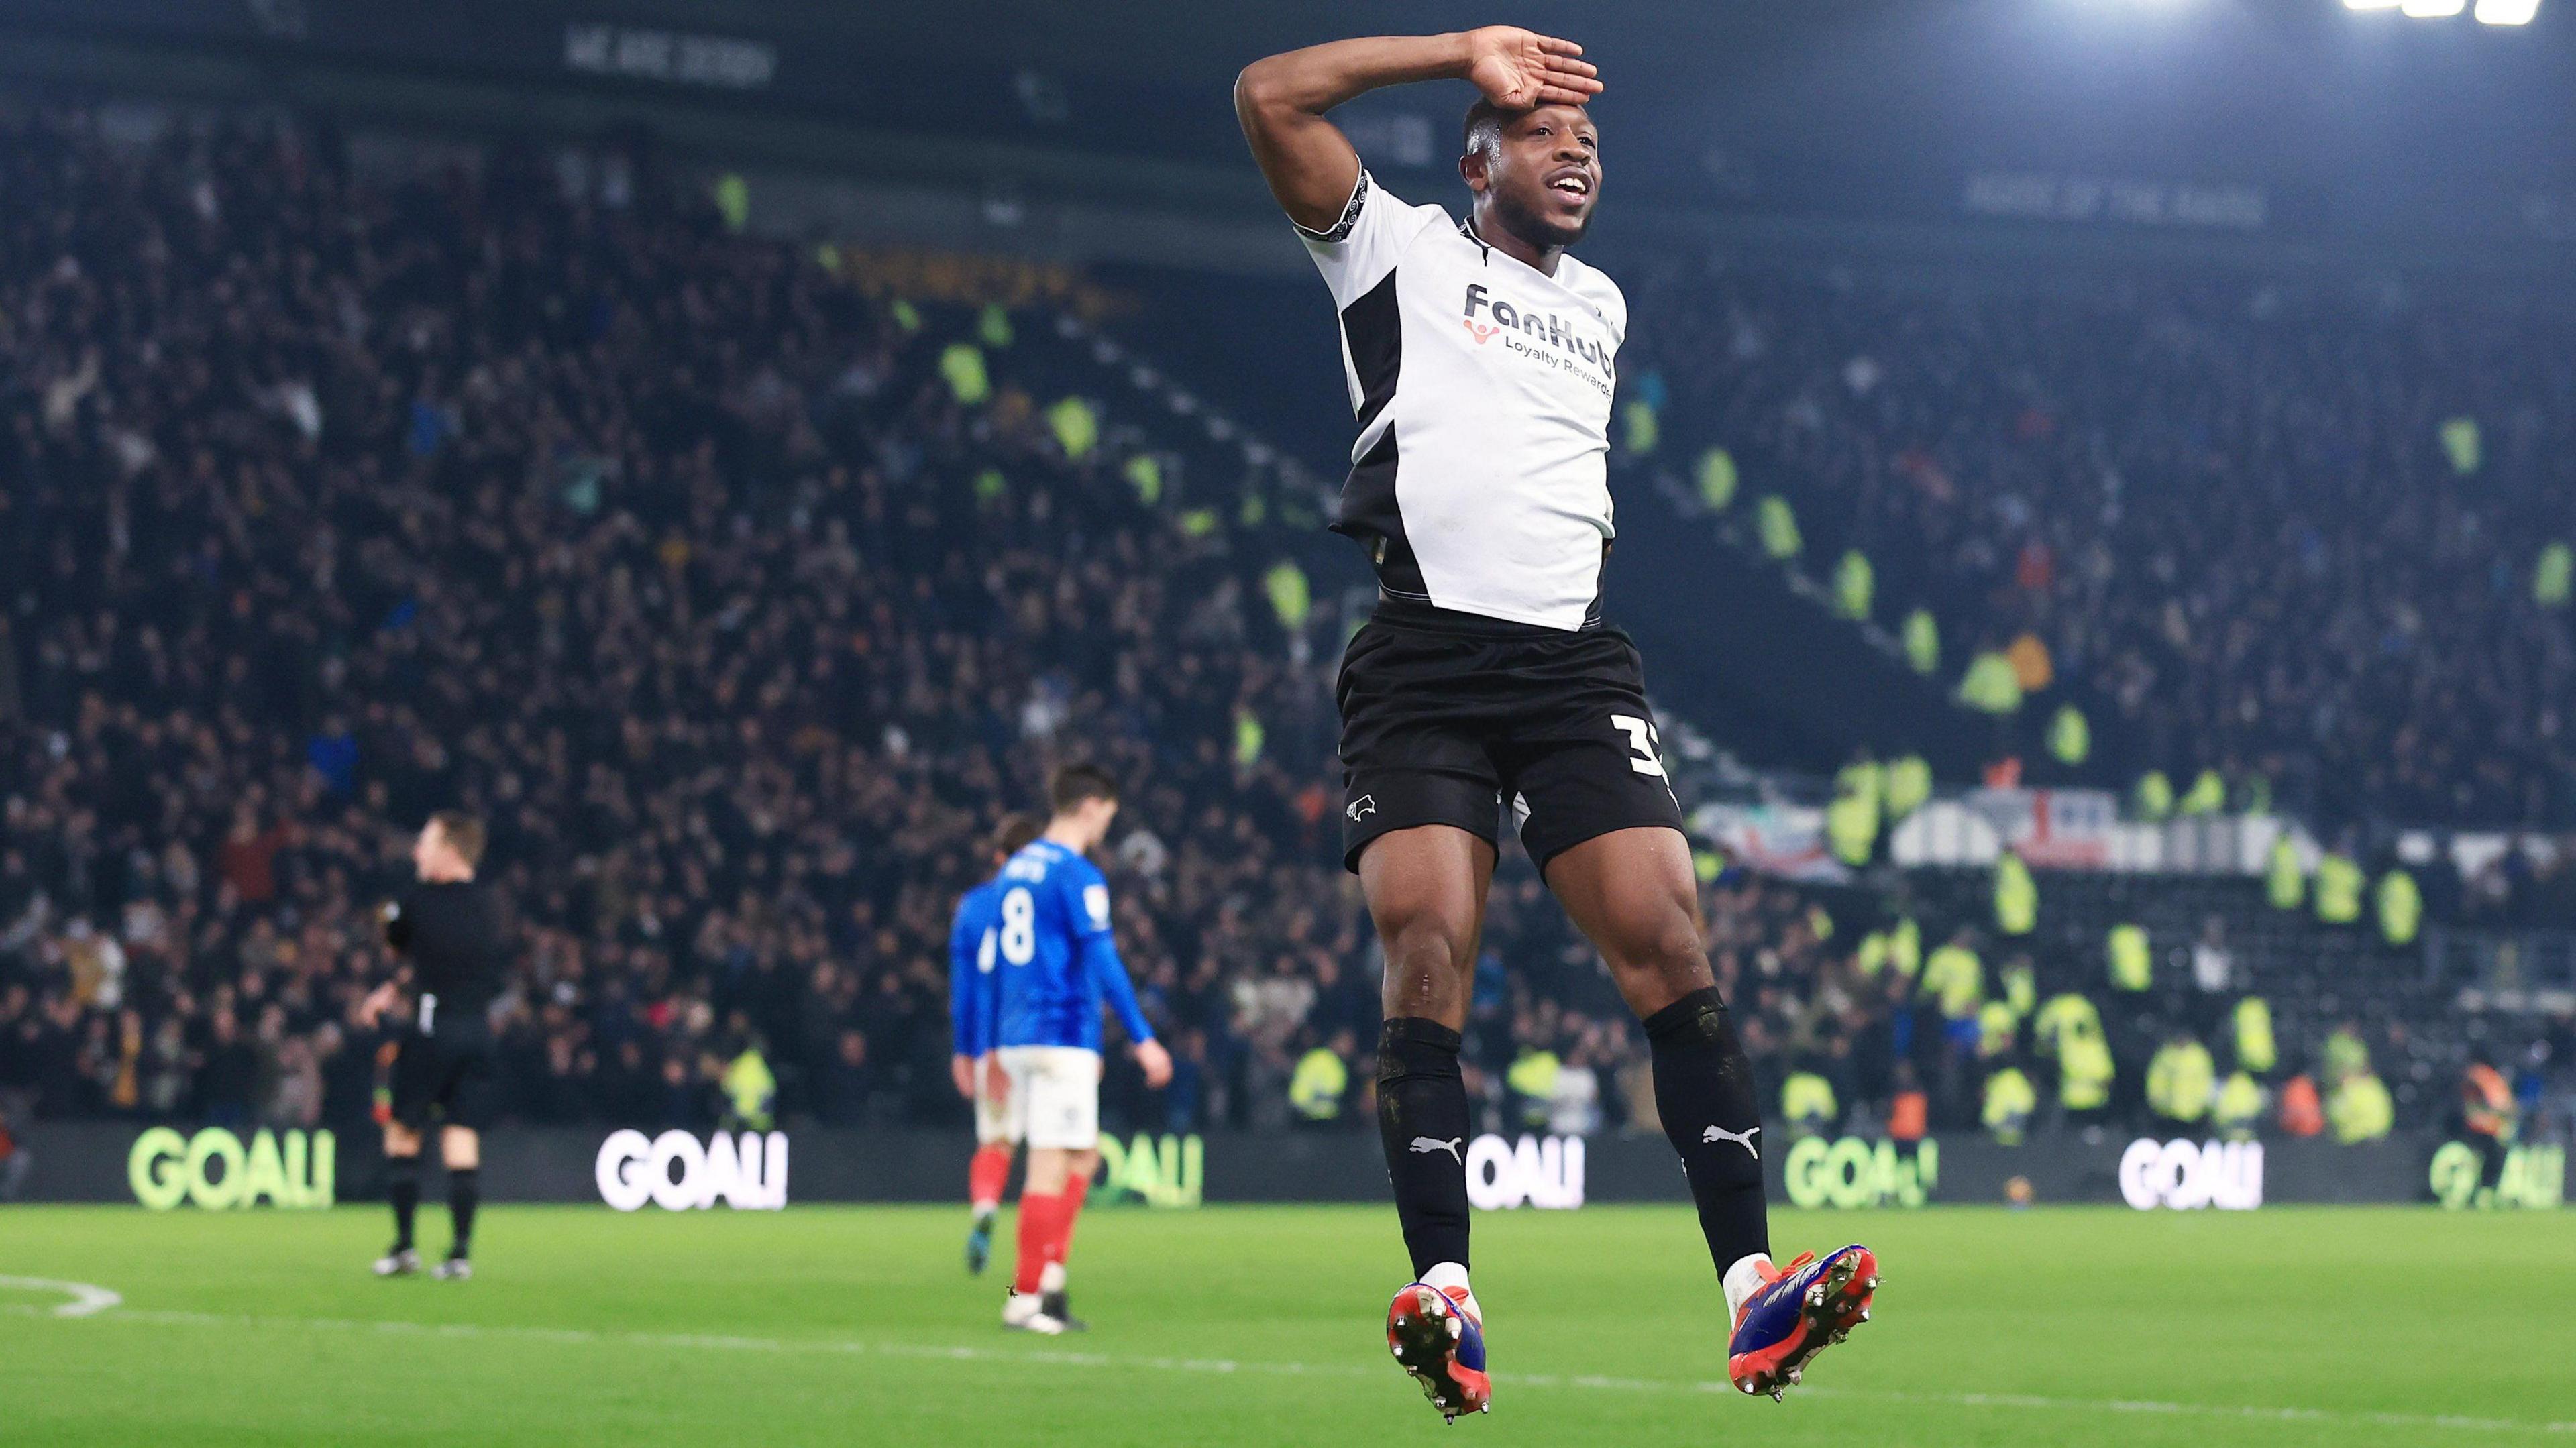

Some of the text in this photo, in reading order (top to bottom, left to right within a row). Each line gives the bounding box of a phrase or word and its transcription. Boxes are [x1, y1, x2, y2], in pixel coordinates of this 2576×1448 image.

[1464, 283, 1612, 380] FanHub
[1505, 335, 1558, 368] Loyalty
[1610, 714, 1666, 781] 3
[1000, 886, 1036, 967] 8
[1466, 1132, 1585, 1210] OAL!
